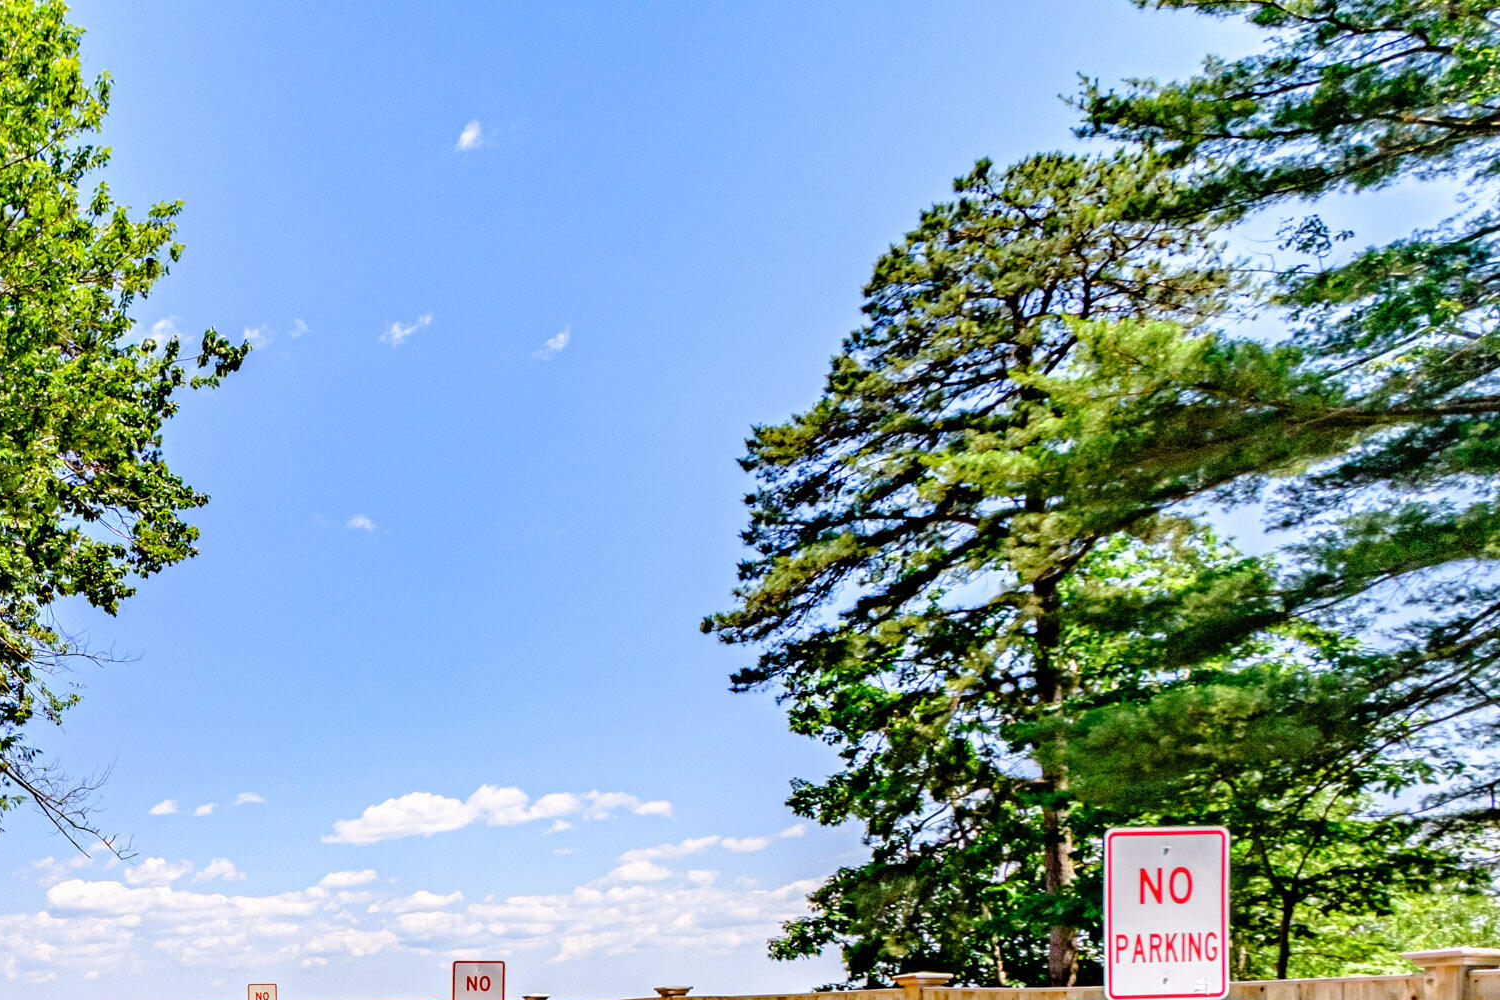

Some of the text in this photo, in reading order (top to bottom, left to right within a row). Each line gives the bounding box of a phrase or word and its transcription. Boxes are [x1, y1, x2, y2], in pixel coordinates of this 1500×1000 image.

[1140, 866, 1193, 905] NO
[1115, 932, 1218, 963] PARKING
[255, 991, 270, 1000] NO
[466, 975, 491, 992] NO
